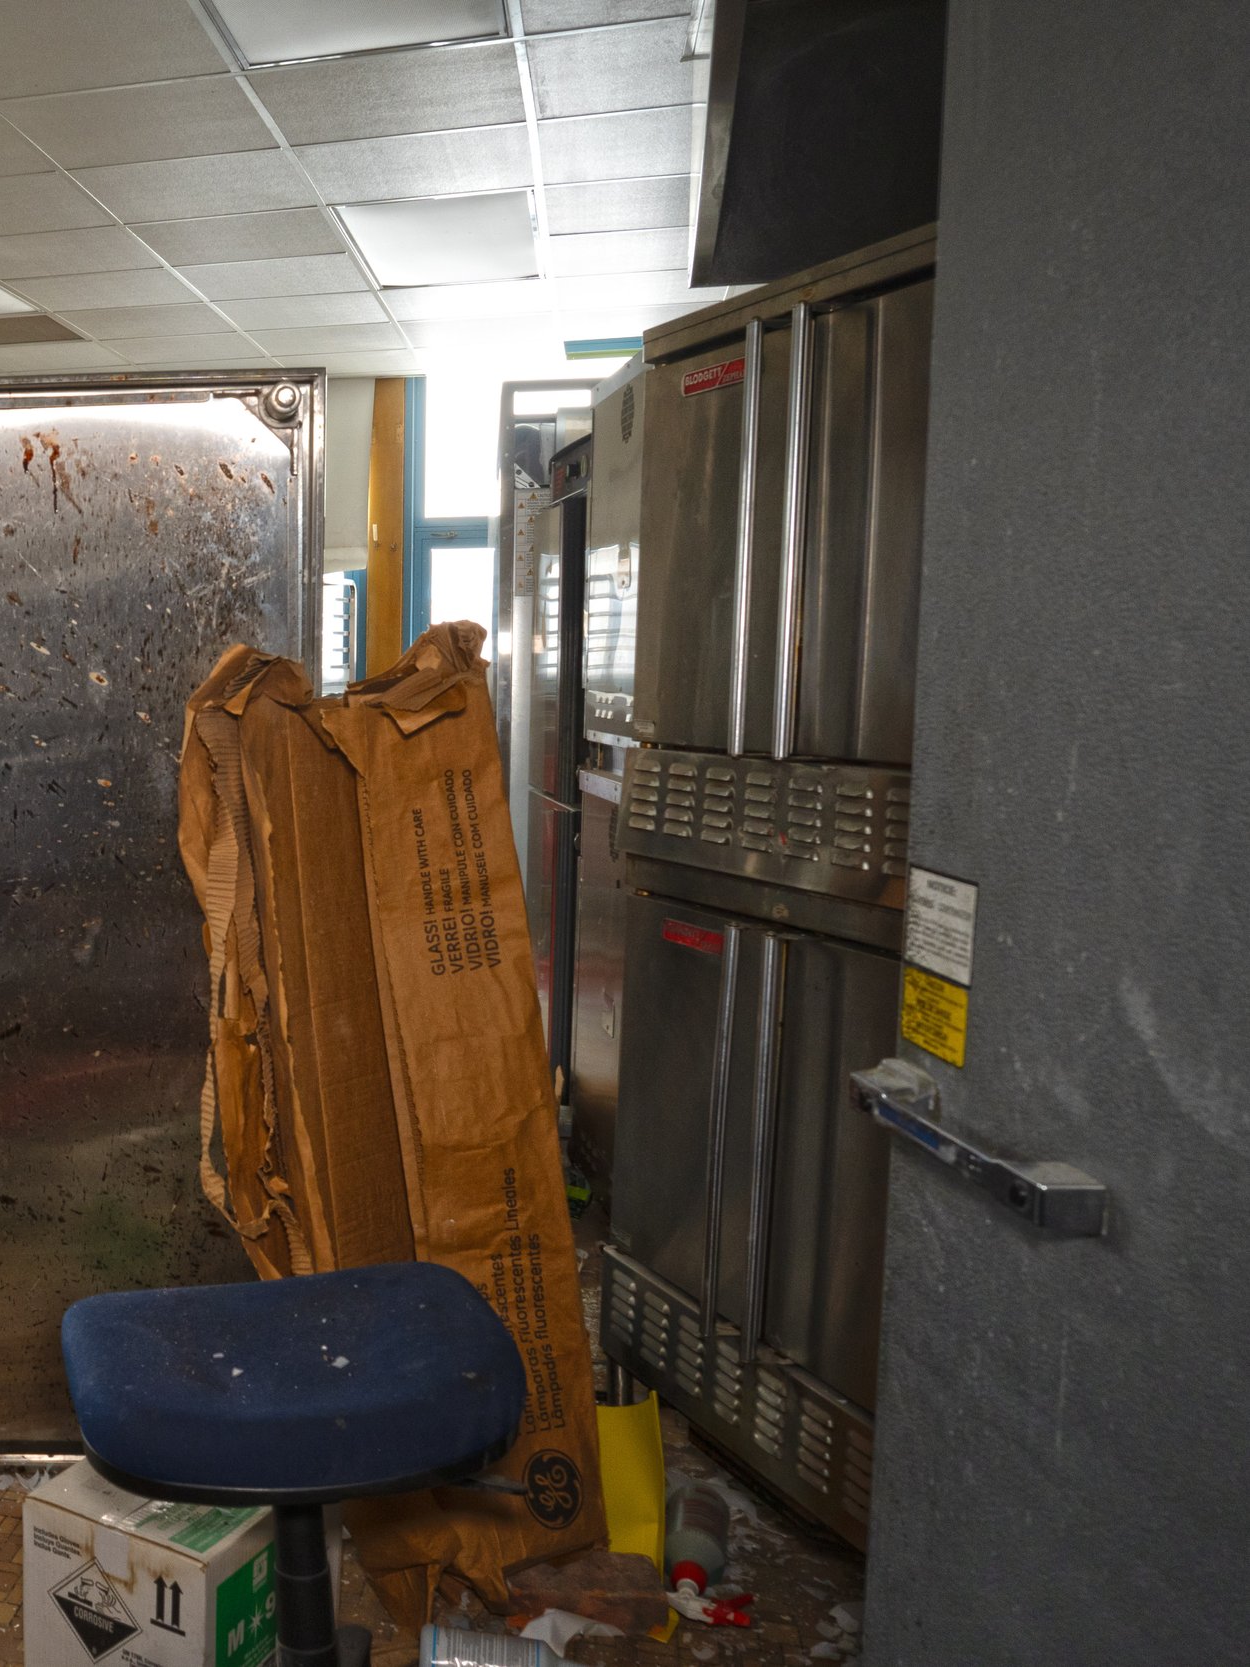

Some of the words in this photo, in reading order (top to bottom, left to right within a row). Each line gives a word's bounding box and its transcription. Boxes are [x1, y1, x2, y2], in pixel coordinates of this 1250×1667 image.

[685, 366, 723, 386] BLODGETT
[444, 769, 459, 820] CUIDADO
[462, 769, 478, 821] CUIDADO
[412, 808, 425, 837] CARE
[451, 823, 464, 848] CON
[470, 823, 483, 849] COM
[417, 839, 429, 870] WITH
[455, 850, 472, 906] MANIPULE
[475, 851, 492, 907] MANUSEIE
[420, 871, 435, 915] HANDLE
[439, 868, 454, 913] FRAGILE
[423, 919, 446, 976] GLASS!
[442, 917, 464, 974] VERRE!
[460, 908, 483, 971] VIDRIO!
[479, 910, 501, 968] VIDRO!
[501, 1167, 519, 1232] Lineales
[527, 1233, 549, 1340] fluorescentes
[73, 1605, 115, 1633] CORROSIVE
[227, 1619, 245, 1657] M
